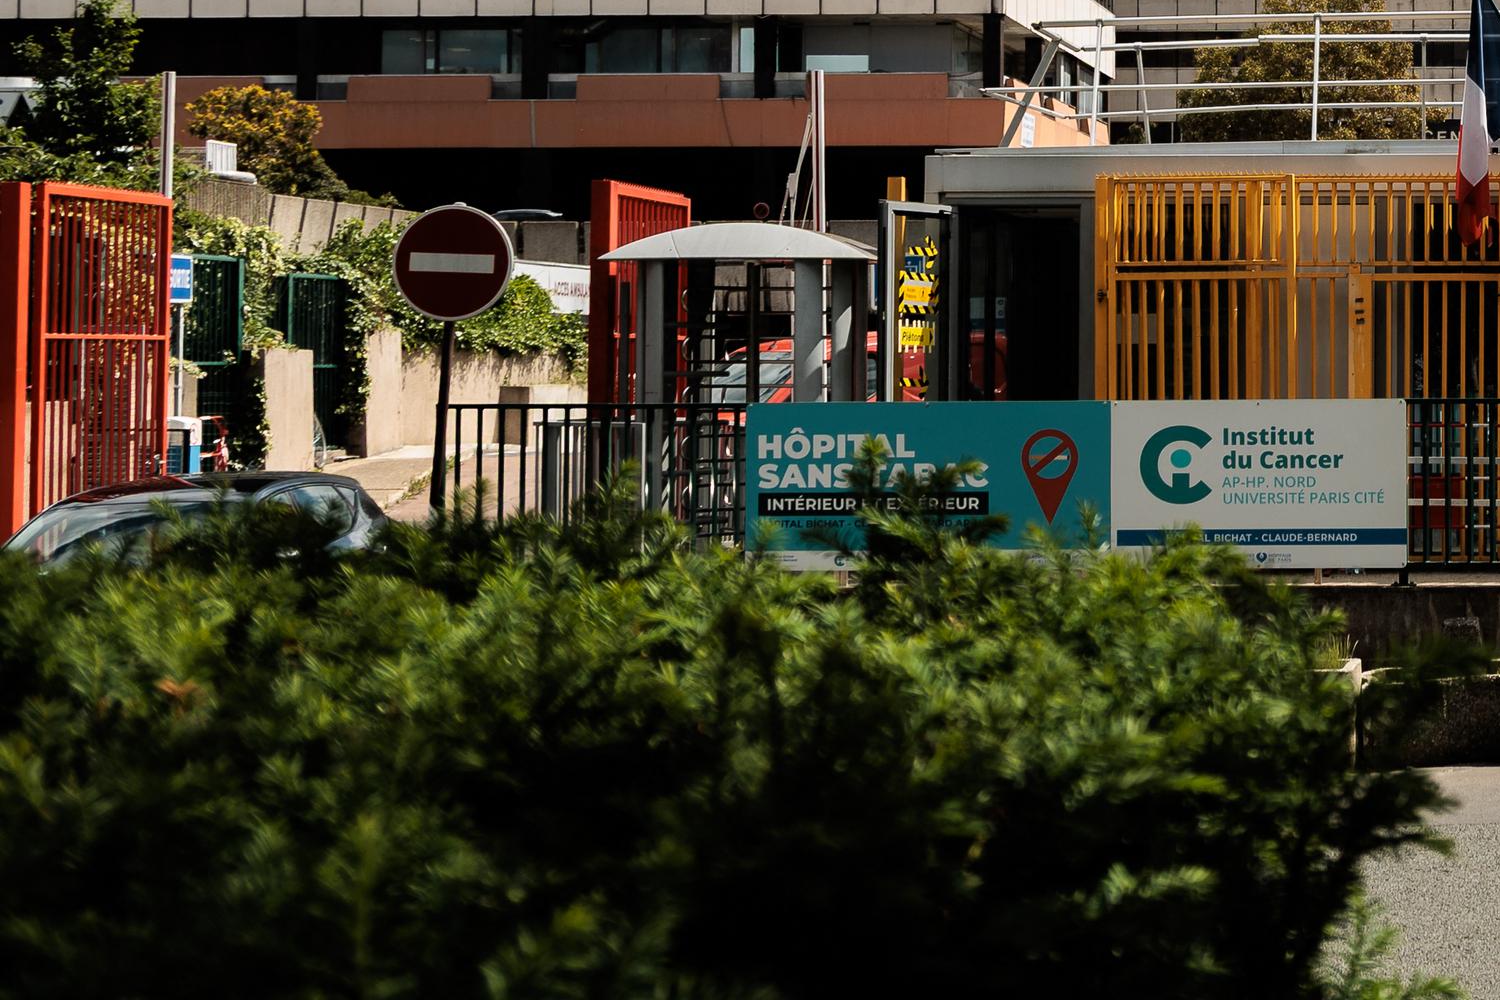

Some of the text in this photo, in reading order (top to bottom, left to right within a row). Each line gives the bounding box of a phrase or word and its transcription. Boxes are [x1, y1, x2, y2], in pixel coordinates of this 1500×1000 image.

[1222, 426, 1314, 446] Institut
[1222, 450, 1343, 469] du Cancer
[758, 463, 853, 489] SANS
[1274, 476, 1316, 488] NORD
[767, 494, 857, 511] INTÉRIEUR
[1223, 489, 1385, 504] UNIVERSITÉ PARIS CITÉ
[1214, 533, 1252, 543] BICHAT
[1261, 533, 1357, 543] CLAUDE-BERNARD
